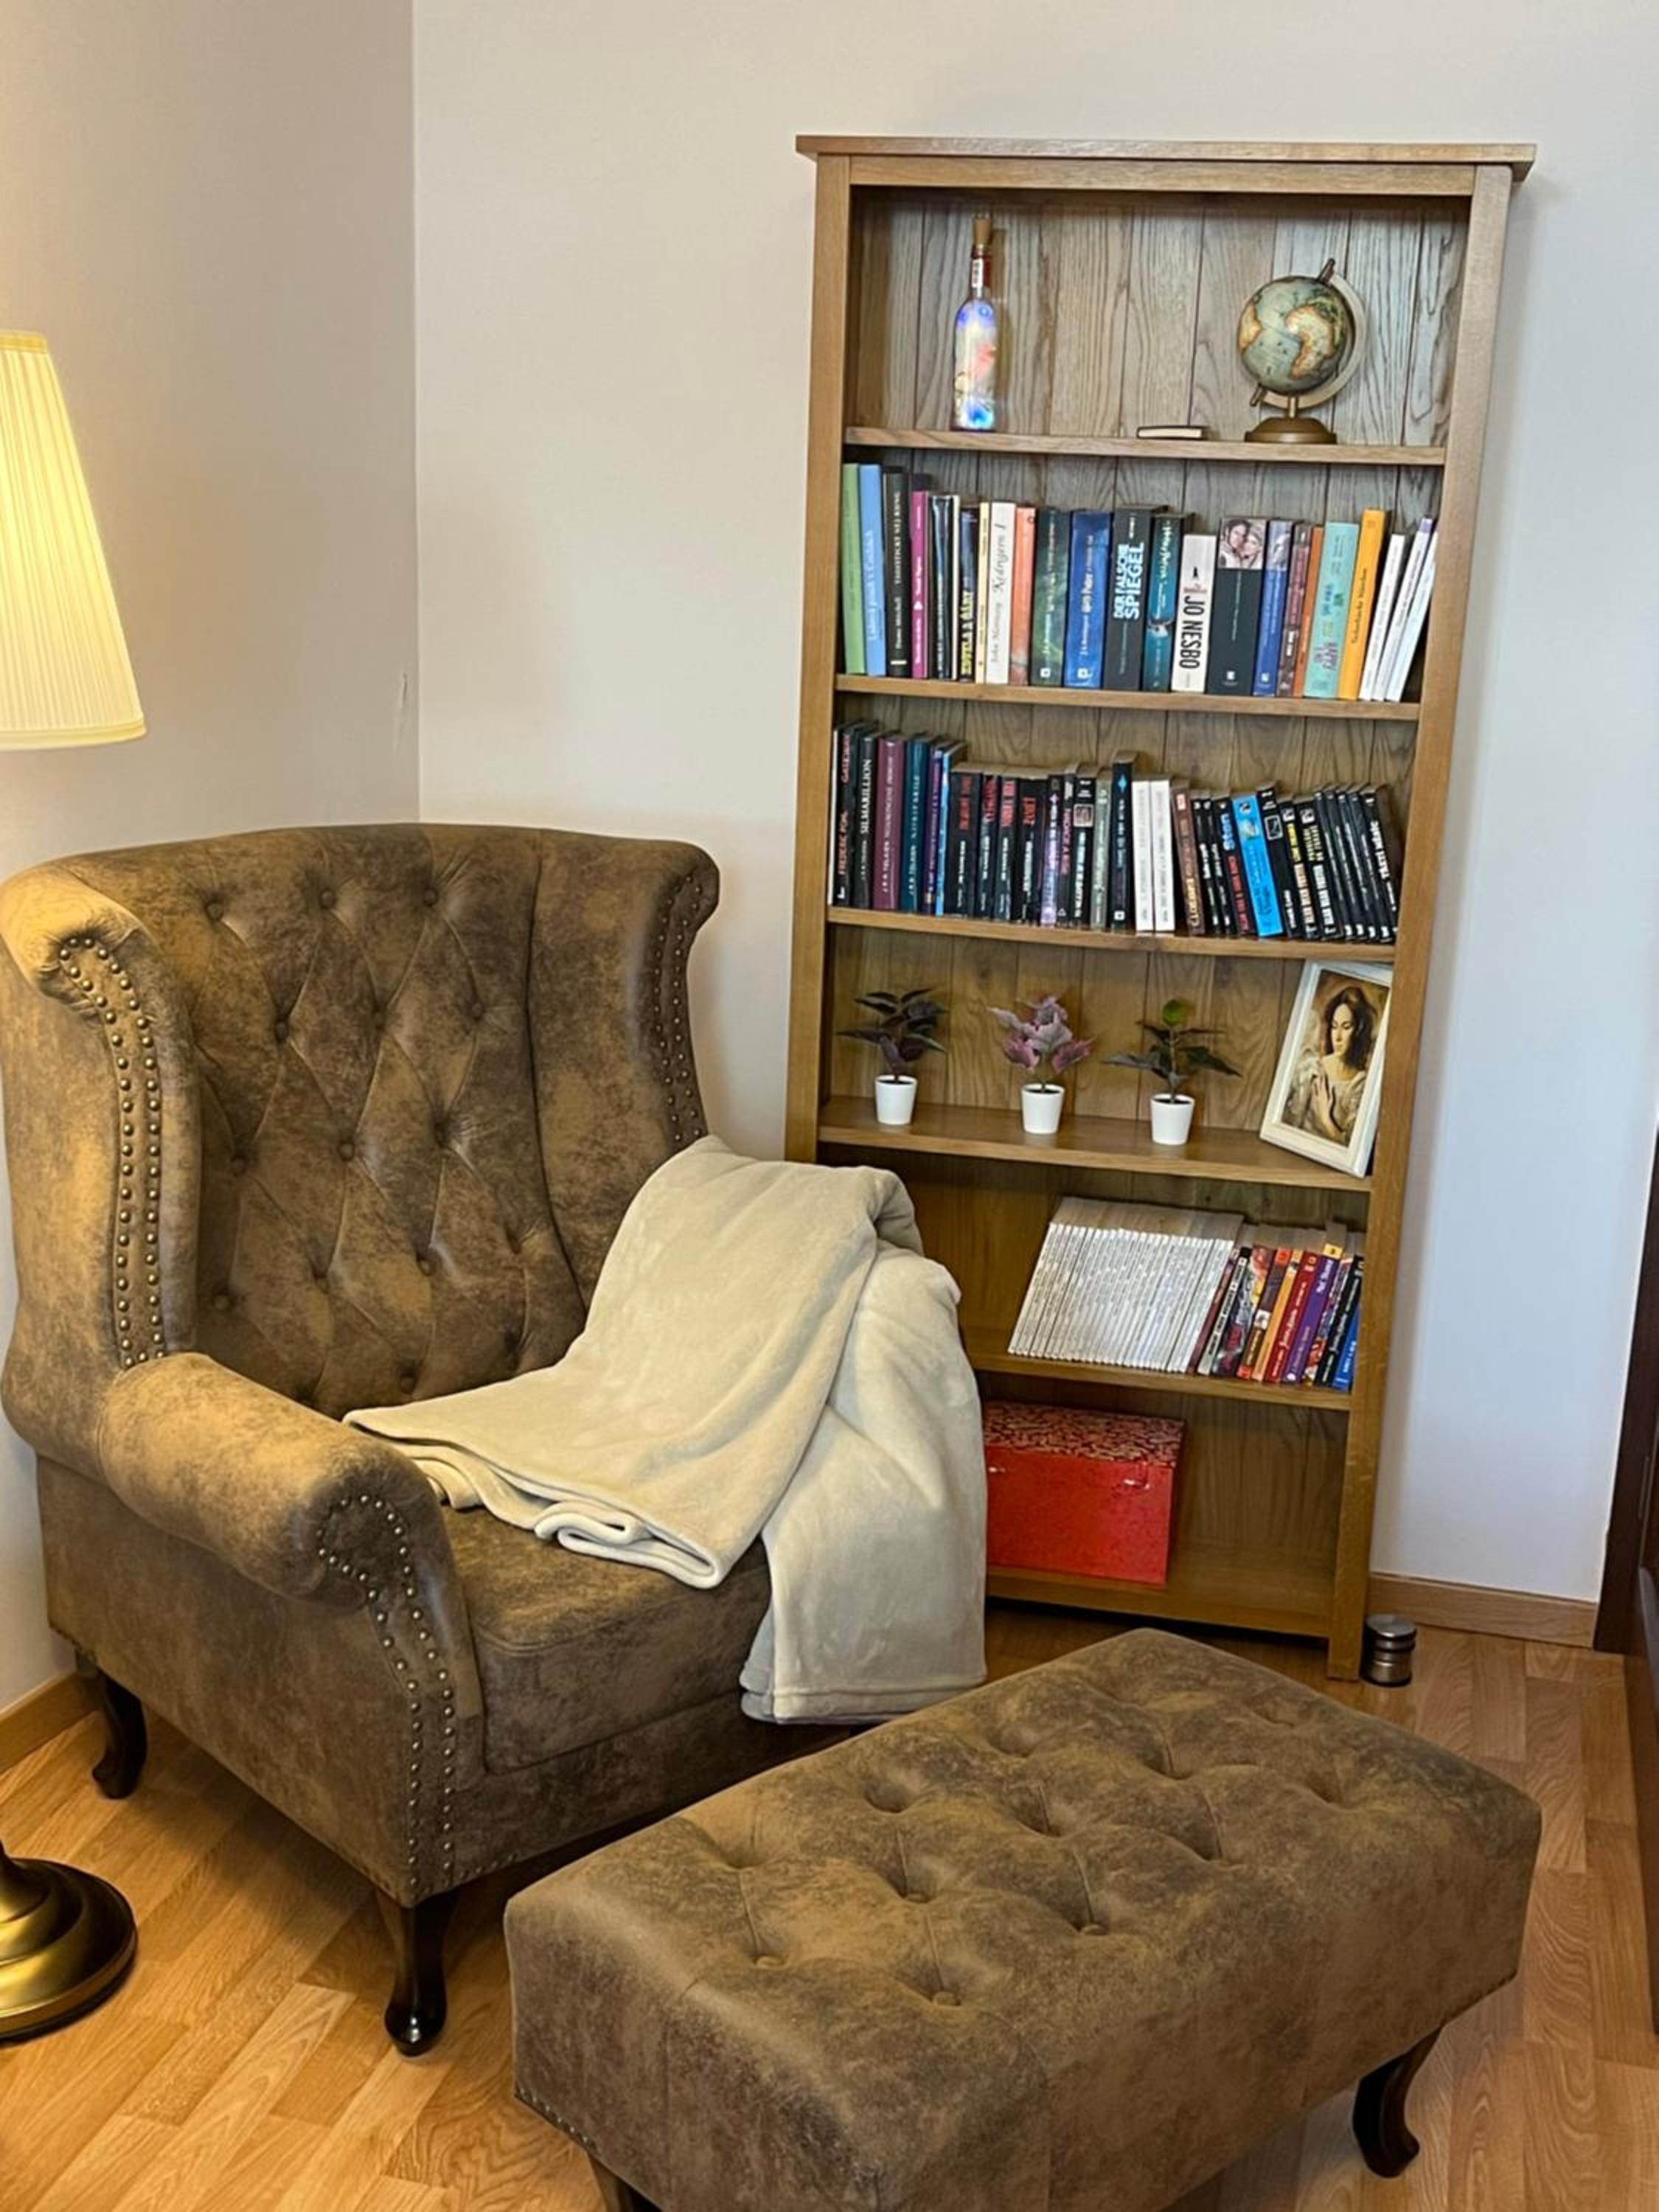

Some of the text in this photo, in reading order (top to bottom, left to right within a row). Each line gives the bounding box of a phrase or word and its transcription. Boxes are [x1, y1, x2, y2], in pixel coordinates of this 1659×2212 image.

[1114, 543, 1129, 594] FALSCHE
[1124, 542, 1144, 620] SPIEGEL
[1113, 595, 1125, 619] DER
[1183, 595, 1205, 616] JO
[860, 758, 872, 835] SILMARILLION
